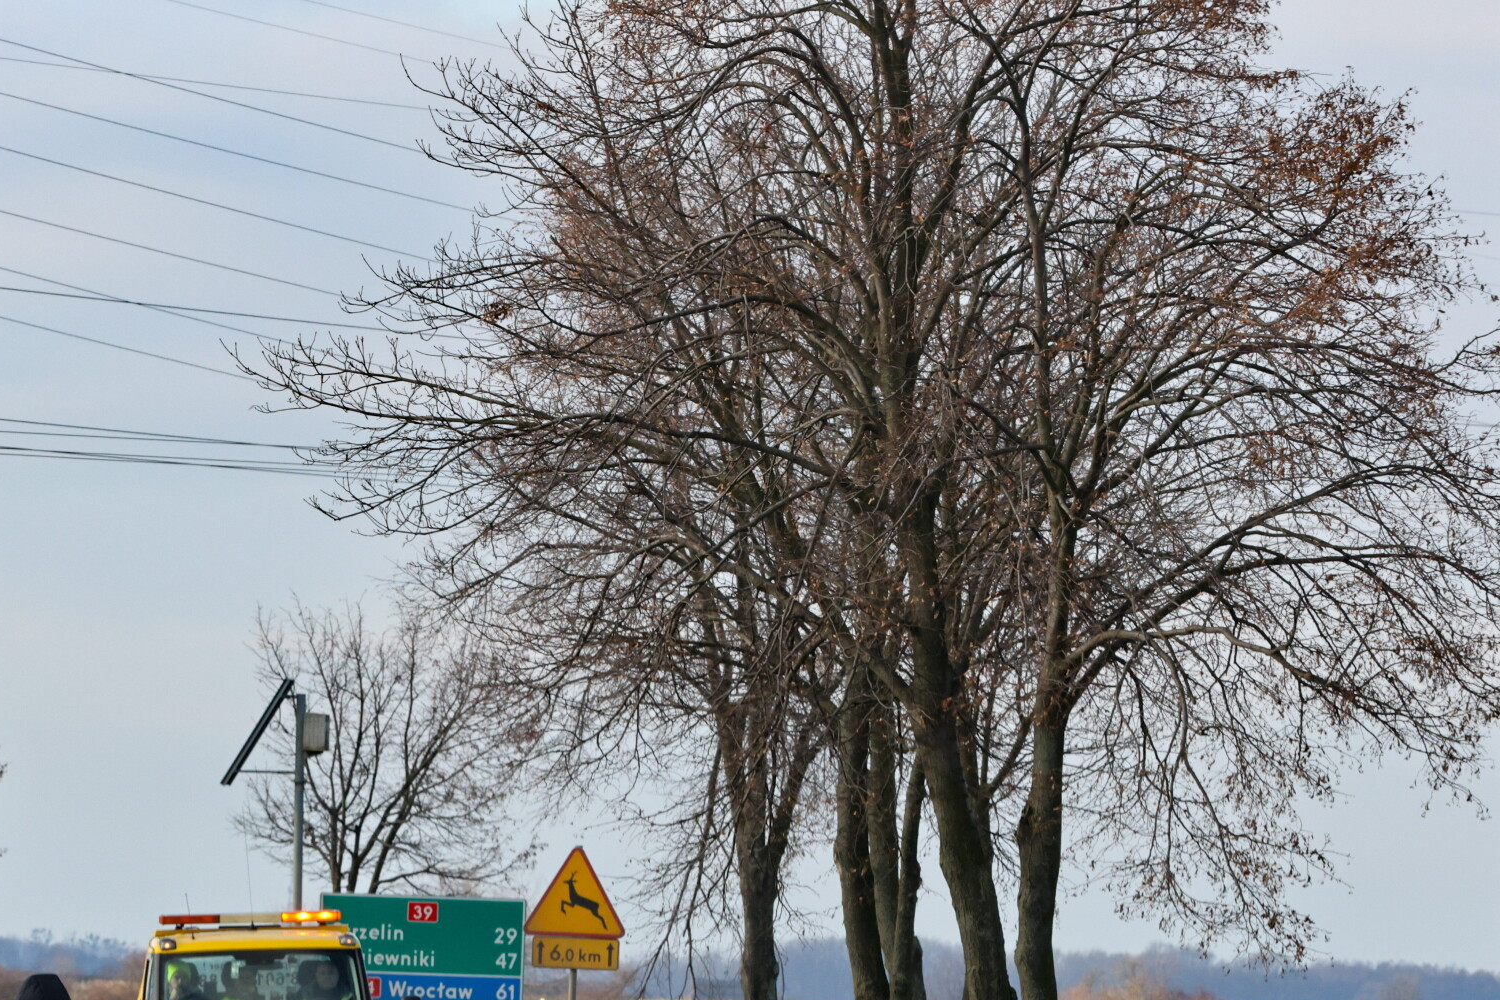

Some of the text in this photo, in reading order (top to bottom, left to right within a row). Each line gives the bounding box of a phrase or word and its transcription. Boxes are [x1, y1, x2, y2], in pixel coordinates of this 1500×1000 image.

[413, 904, 433, 920] 39
[352, 923, 518, 945] rzelin 29
[363, 949, 518, 970] iewniki 47
[549, 944, 601, 963] 6,0 km
[388, 980, 474, 1000] Wrocław
[495, 982, 516, 1000] 61
